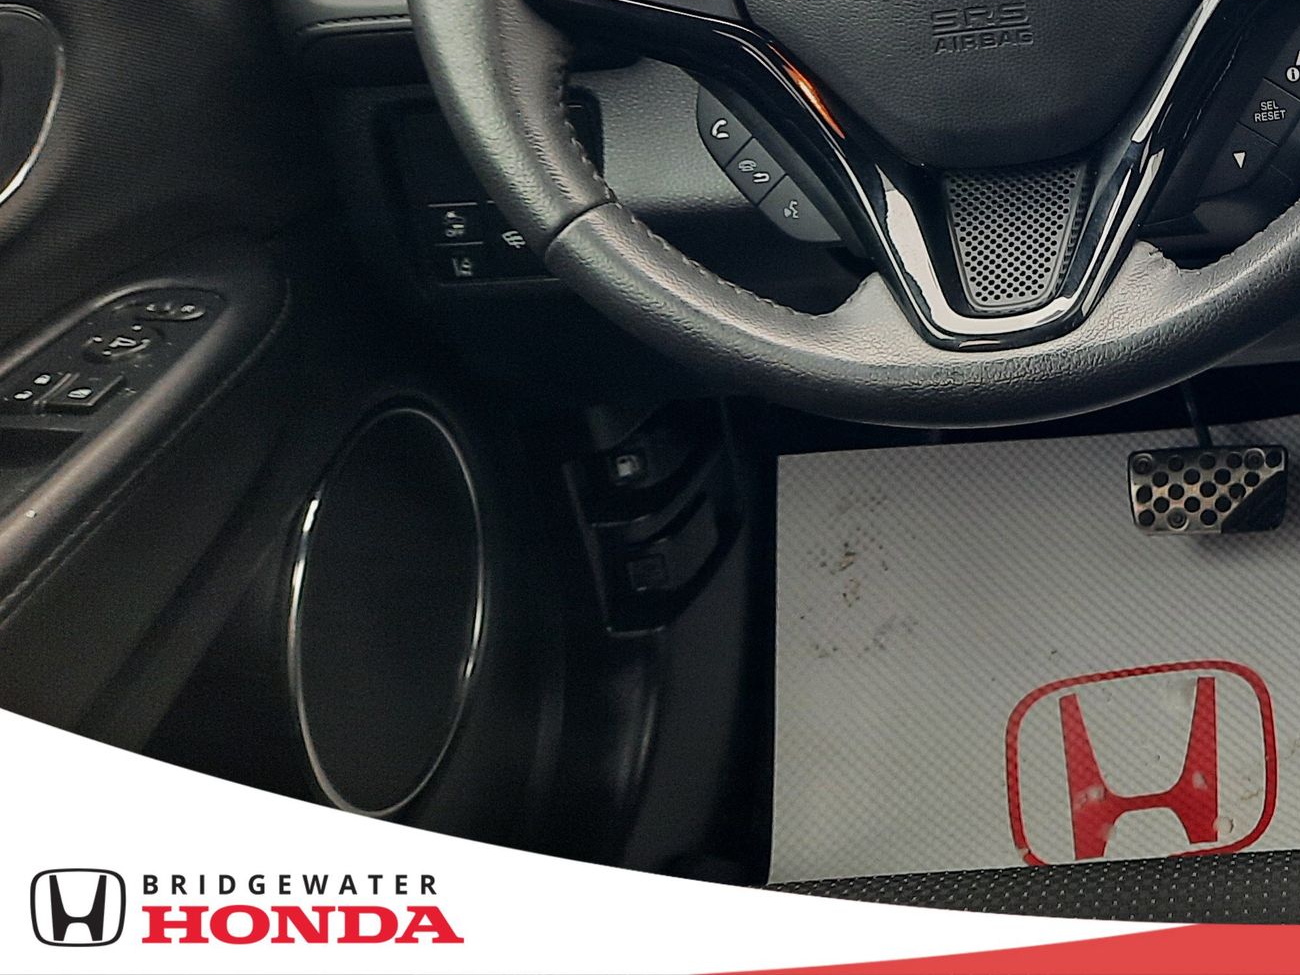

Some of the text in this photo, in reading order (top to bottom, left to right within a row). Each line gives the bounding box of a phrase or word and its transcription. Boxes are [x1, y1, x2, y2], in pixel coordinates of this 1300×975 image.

[930, 3, 1031, 29] SRS
[933, 30, 1034, 54] AIRBAG
[1260, 100, 1279, 111] SEL
[1254, 110, 1286, 123] RESET
